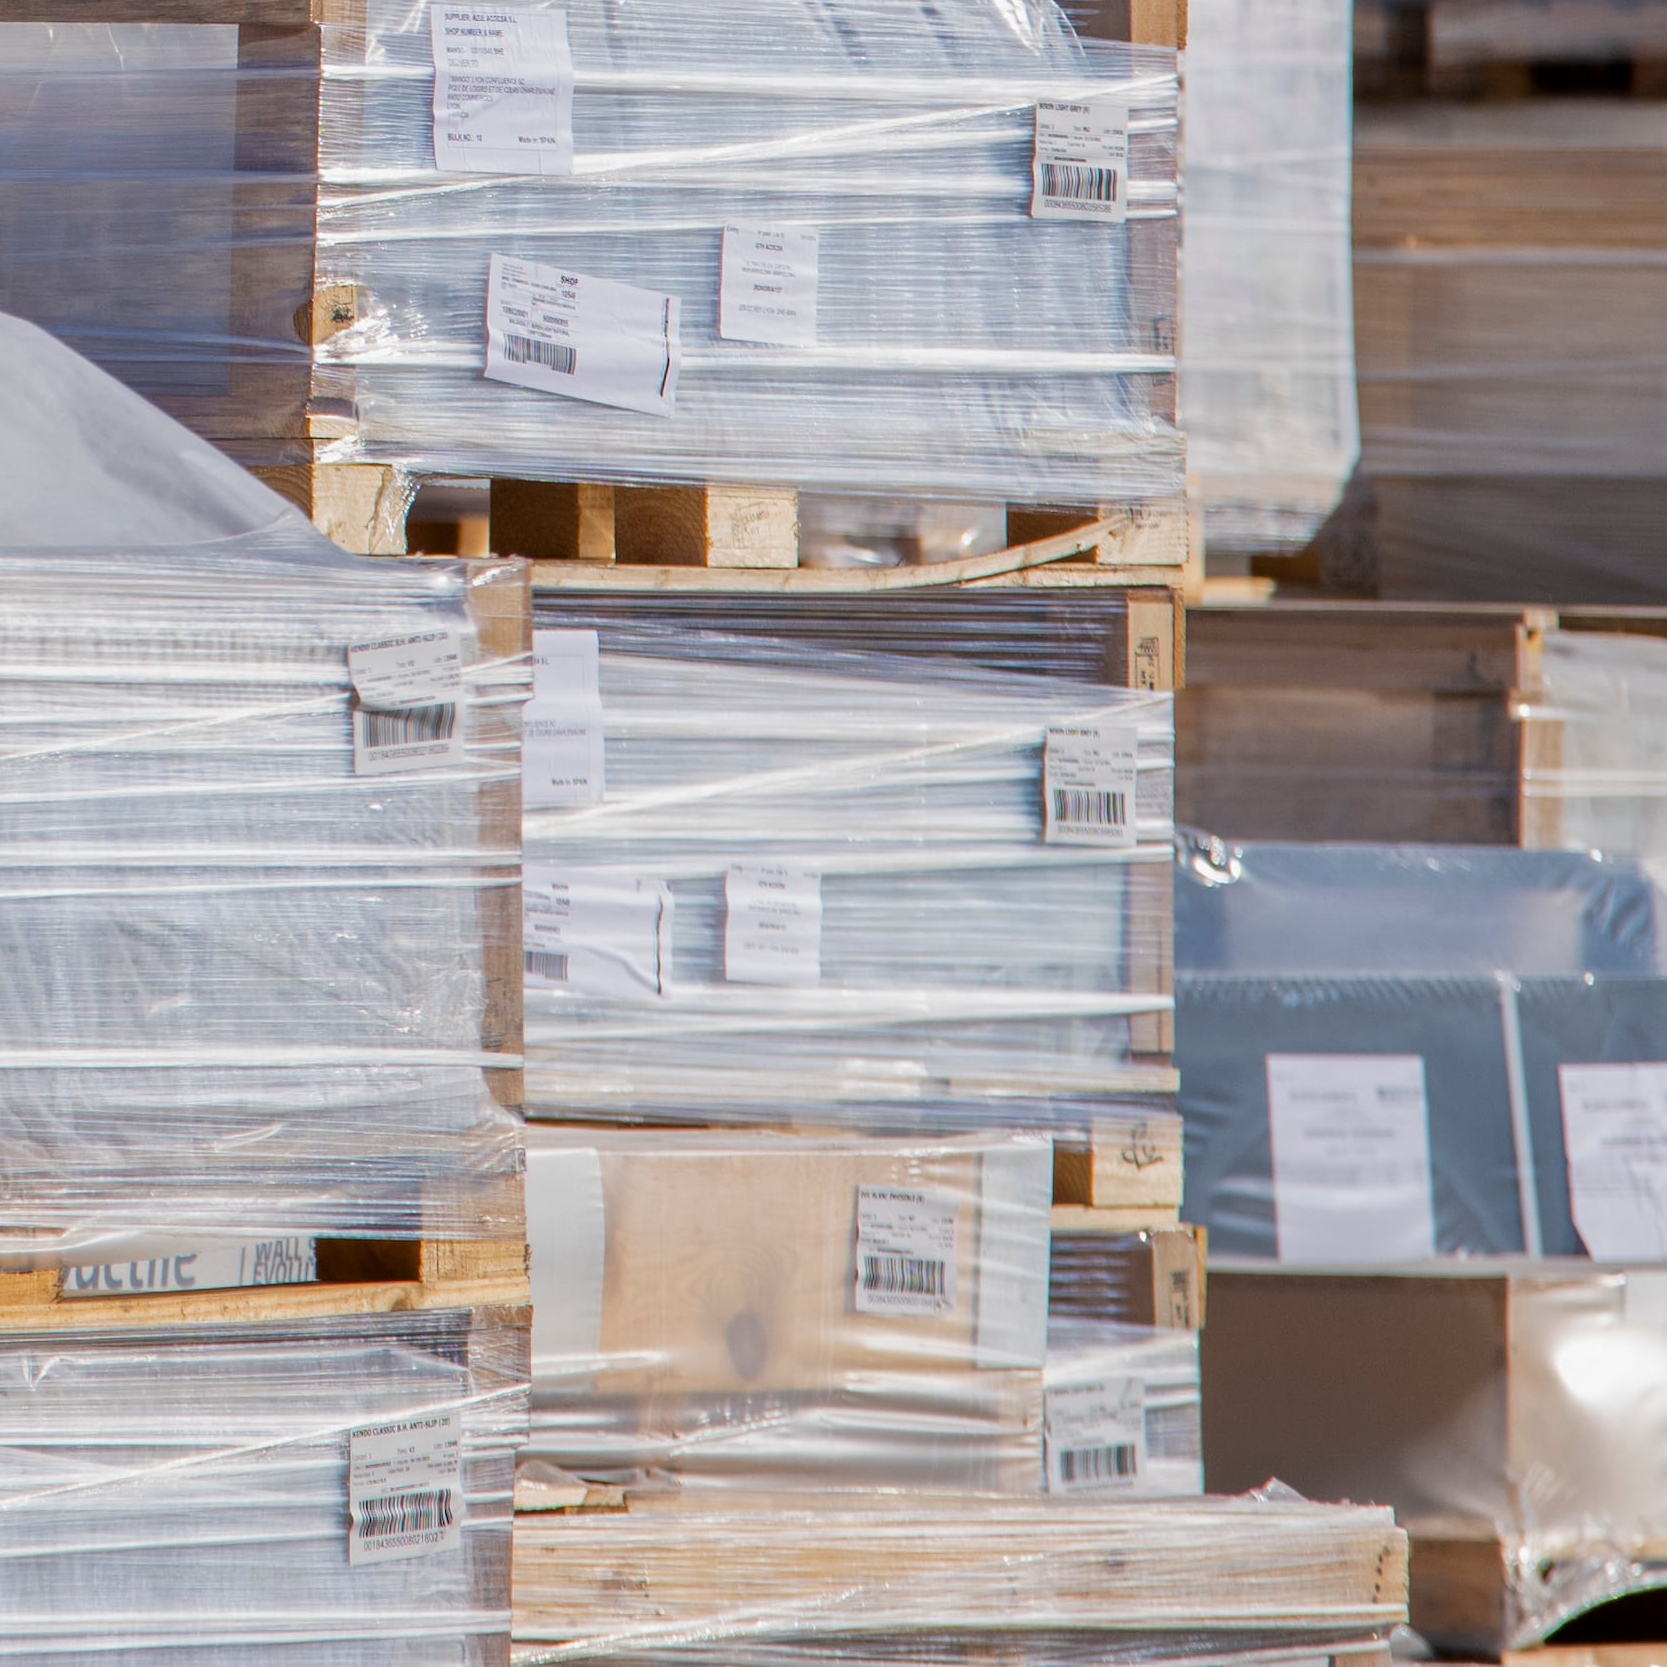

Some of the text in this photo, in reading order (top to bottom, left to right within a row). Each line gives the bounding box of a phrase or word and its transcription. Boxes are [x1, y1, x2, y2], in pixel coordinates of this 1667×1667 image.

[255, 1237, 303, 1262] WALL
[352, 1429, 371, 1438] KENDO
[372, 1425, 396, 1435] CLASSIC
[409, 1419, 438, 1430] ANTI-SLIP
